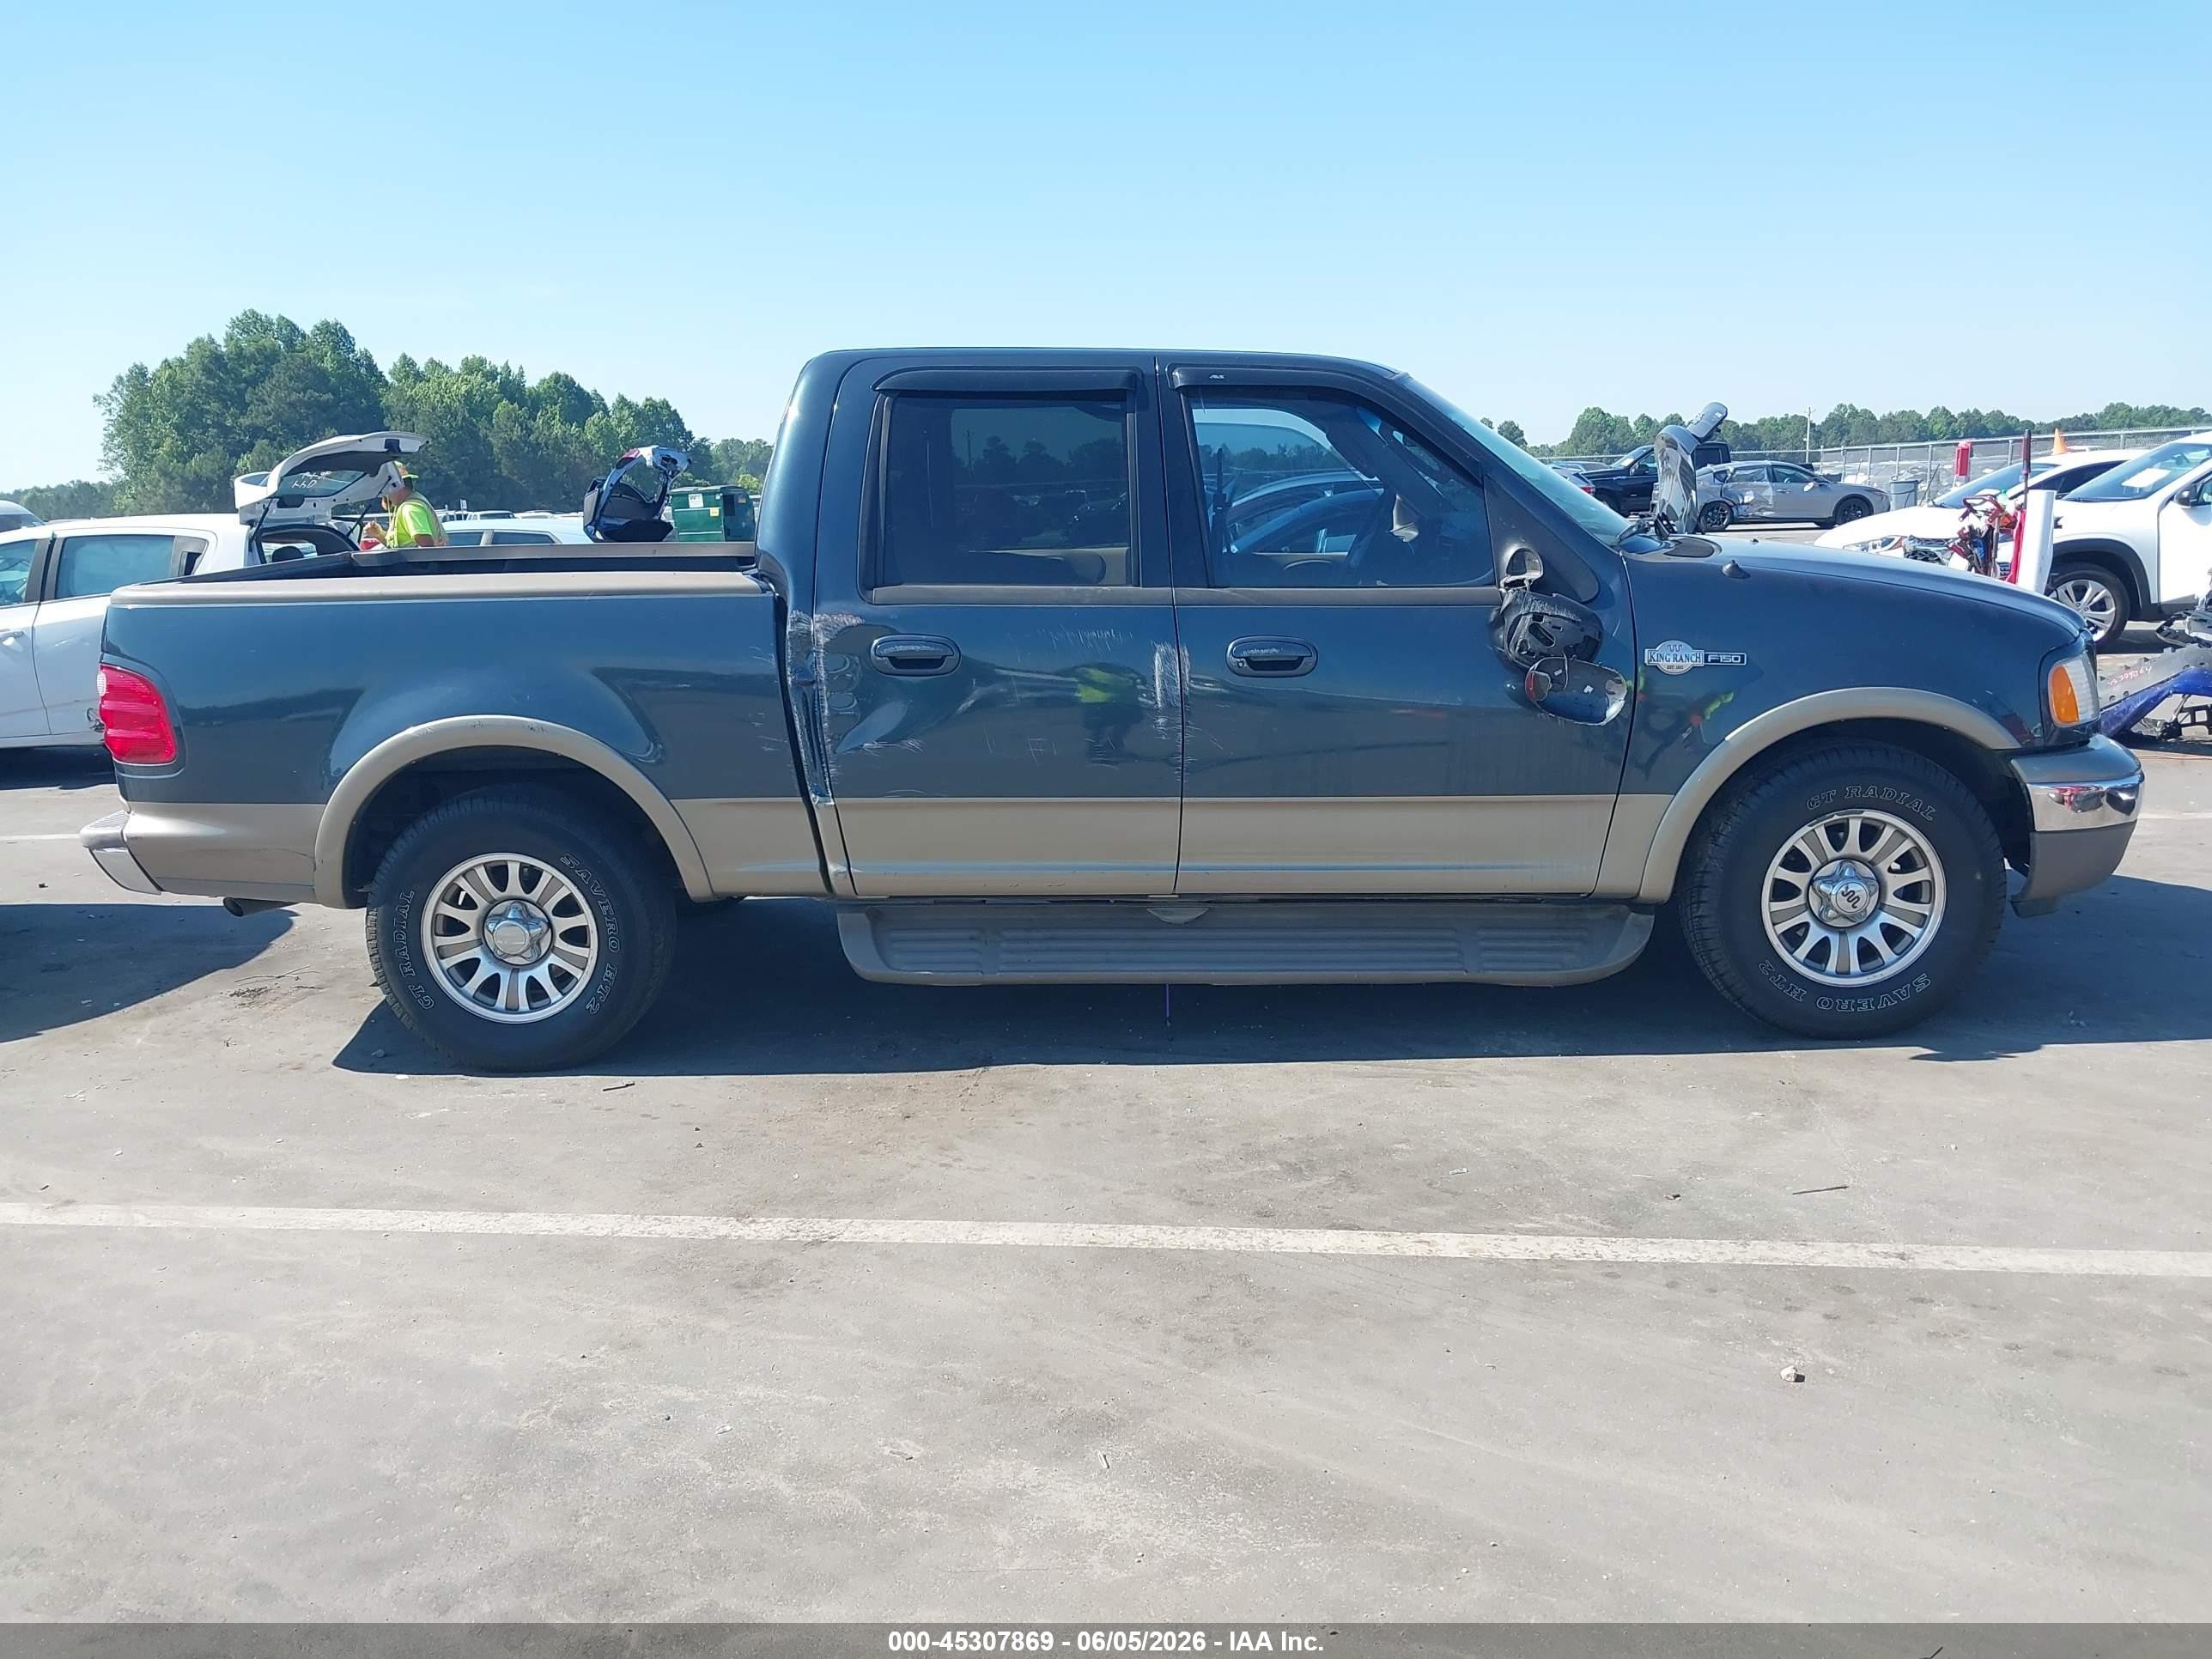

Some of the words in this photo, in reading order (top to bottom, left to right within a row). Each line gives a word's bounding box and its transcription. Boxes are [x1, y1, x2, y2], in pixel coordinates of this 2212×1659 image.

[1649, 652, 1671, 663] KING
[1673, 653, 1702, 663] RANCH
[1807, 789, 1837, 810] GT
[1845, 786, 1937, 821] RADIAL
[560, 854, 621, 953] SAVERO
[392, 890, 416, 978] RADIAL
[409, 985, 435, 1010] GT
[586, 963, 618, 1016] HT2
[1758, 962, 1808, 1002] HT2
[1816, 973, 1932, 1012] SAVERO
